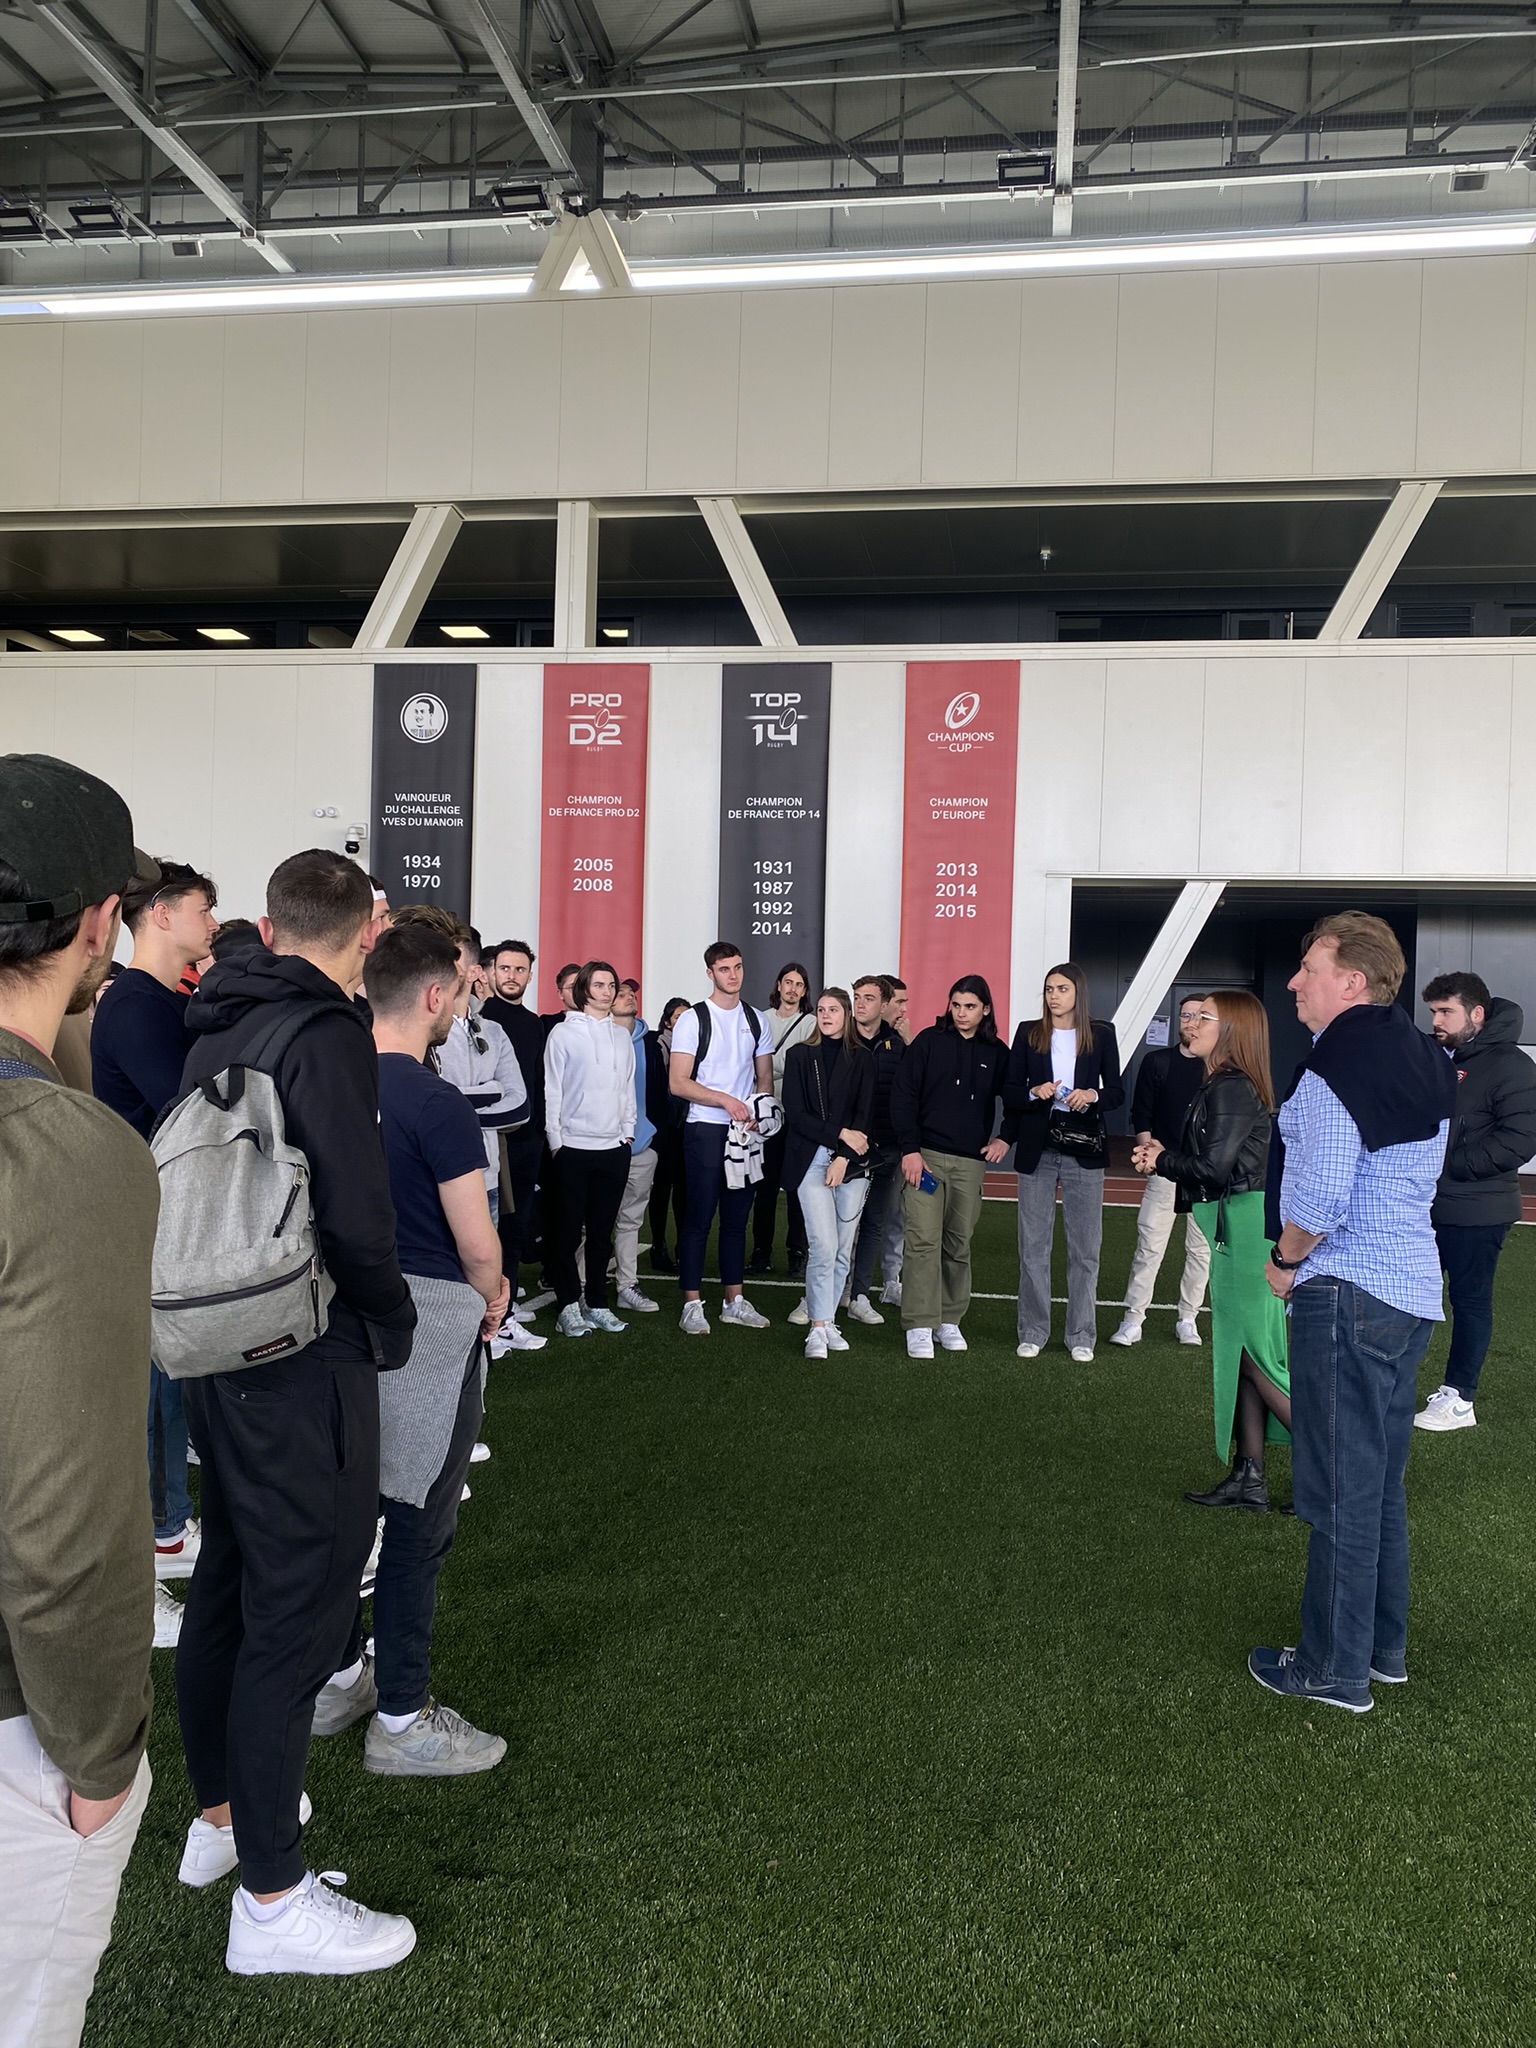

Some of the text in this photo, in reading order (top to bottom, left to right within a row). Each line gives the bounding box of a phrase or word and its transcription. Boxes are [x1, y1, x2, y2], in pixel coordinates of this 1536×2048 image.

[570, 693, 622, 707] PRO
[750, 692, 802, 707] TOP
[569, 723, 623, 745] D2
[752, 723, 798, 746] 14
[927, 732, 995, 742] CHAMPIONS
[948, 743, 972, 752] CUP
[394, 793, 451, 803] VAINQUEUR
[567, 795, 622, 805] CHAMPION
[746, 797, 803, 807] CHAMPION
[929, 797, 989, 807] CHAMPION
[385, 805, 461, 815] DU CHALLENGE
[549, 808, 640, 817] DE FRANCE PRO D2
[728, 810, 821, 819] DE FRANCE TOP 14
[381, 817, 464, 827] YVES DU MANOIR
[402, 855, 442, 869] 1934
[573, 858, 614, 872] 2005
[753, 861, 793, 875] 1931
[936, 863, 978, 877] 2013
[402, 875, 442, 889] 1970
[573, 878, 613, 892] 2008
[753, 881, 794, 895] 1987
[935, 883, 978, 897] 2014
[752, 901, 793, 915] 1992
[935, 904, 977, 918] 2015
[751, 921, 793, 936] 2014
[252, 1342, 288, 1357] EASTPAK
